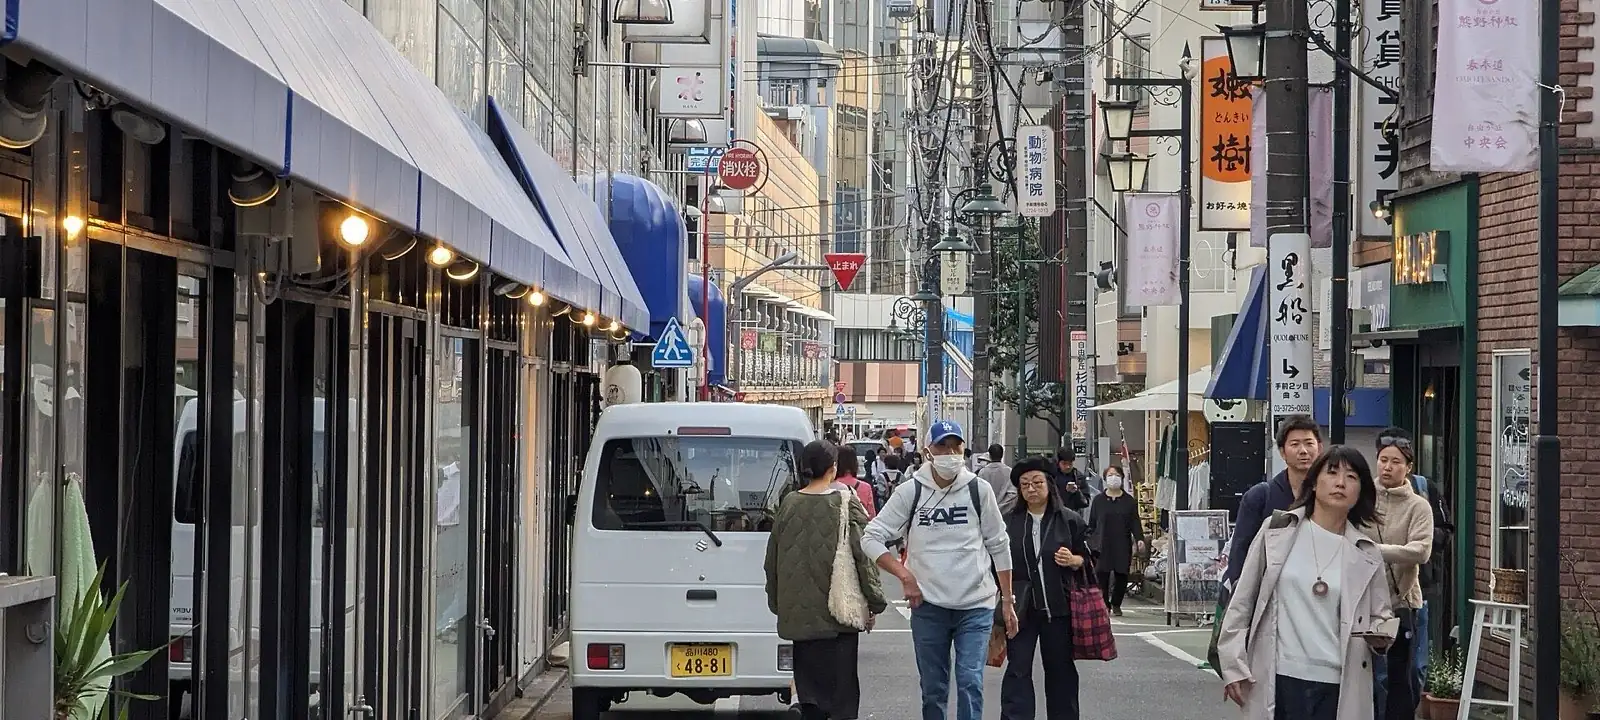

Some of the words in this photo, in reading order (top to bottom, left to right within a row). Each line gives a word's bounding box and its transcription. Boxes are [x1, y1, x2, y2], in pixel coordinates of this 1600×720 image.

[1466, 59, 1503, 71] 表参道
[1464, 136, 1508, 149] 中央会
[722, 160, 757, 177] 消火栓
[1028, 135, 1043, 196] 動物病院
[1206, 202, 1251, 210] お好み焼
[832, 260, 859, 271] 止まれ
[1076, 371, 1088, 421] 杉内医院
[942, 421, 953, 431] LA
[685, 658, 726, 673] 48-81
